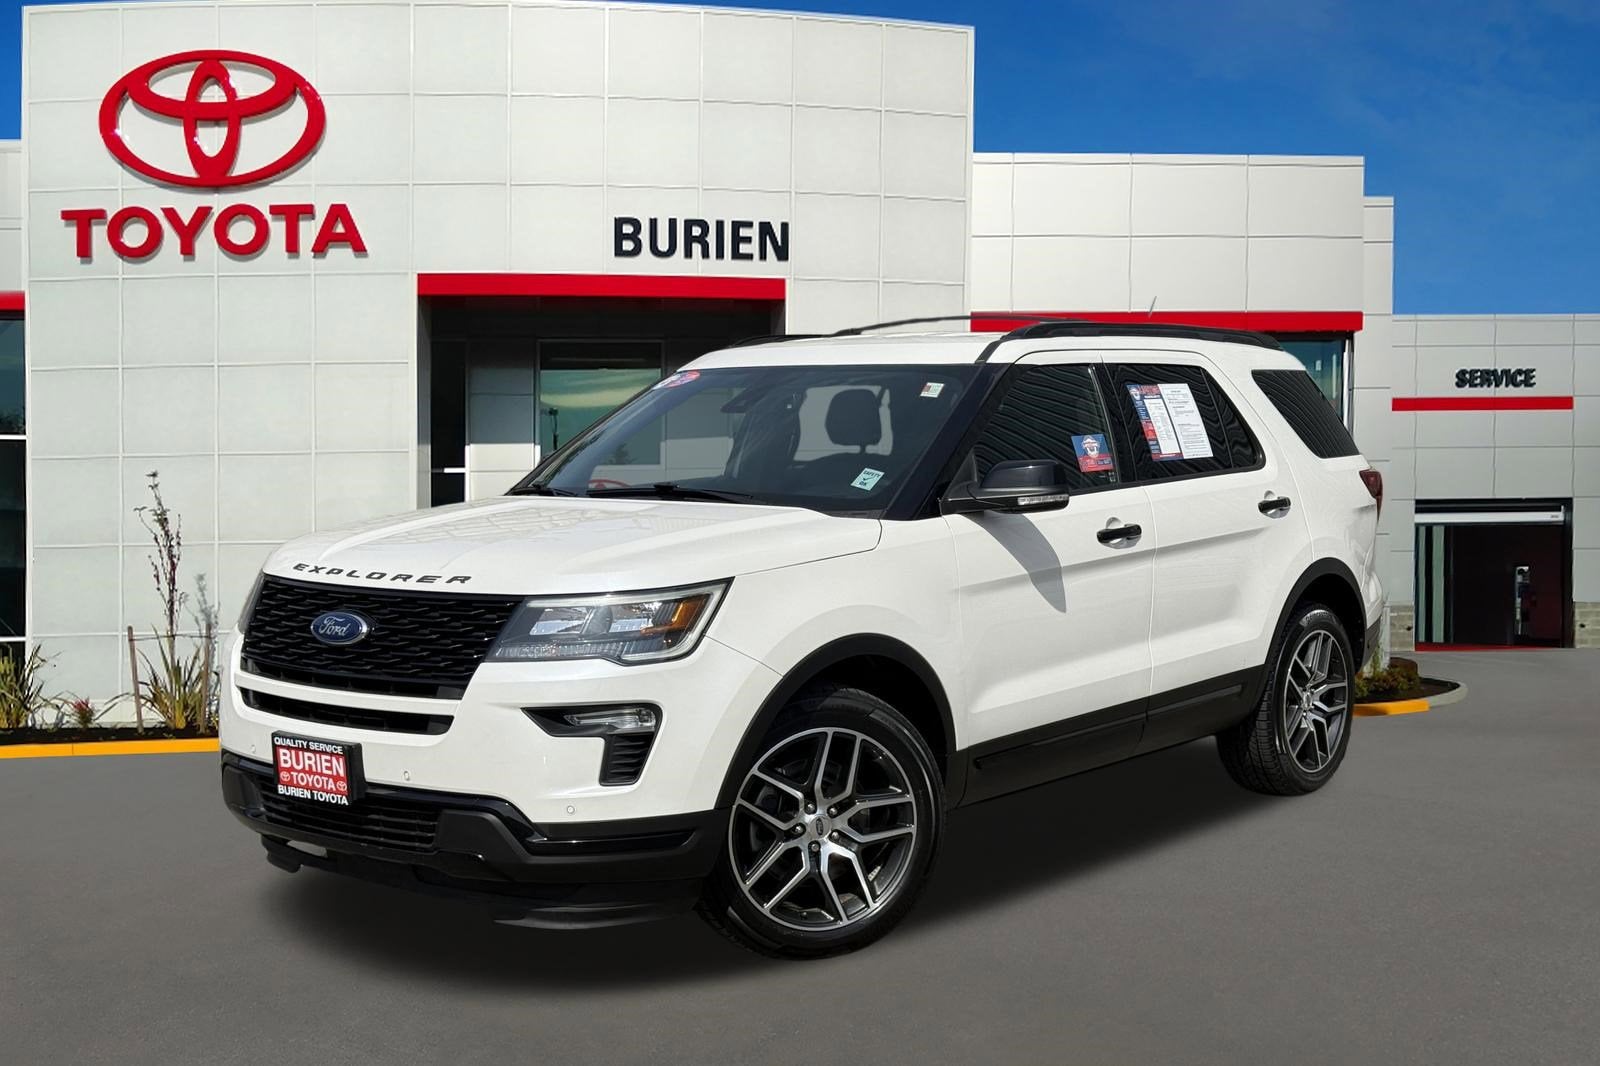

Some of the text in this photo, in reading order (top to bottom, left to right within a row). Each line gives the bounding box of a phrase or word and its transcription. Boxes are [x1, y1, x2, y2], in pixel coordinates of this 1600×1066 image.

[61, 204, 368, 258] TOYOTA
[614, 217, 789, 261] BURIEN
[1455, 368, 1536, 388] SERVICE
[293, 563, 472, 584] EXPLORER
[318, 616, 351, 636] Ford
[274, 737, 343, 754] QUALITY SERVICE
[279, 748, 345, 777] BURIEN
[291, 771, 336, 791] TOYOTA
[277, 784, 349, 806] BURIEN TOYOTA
